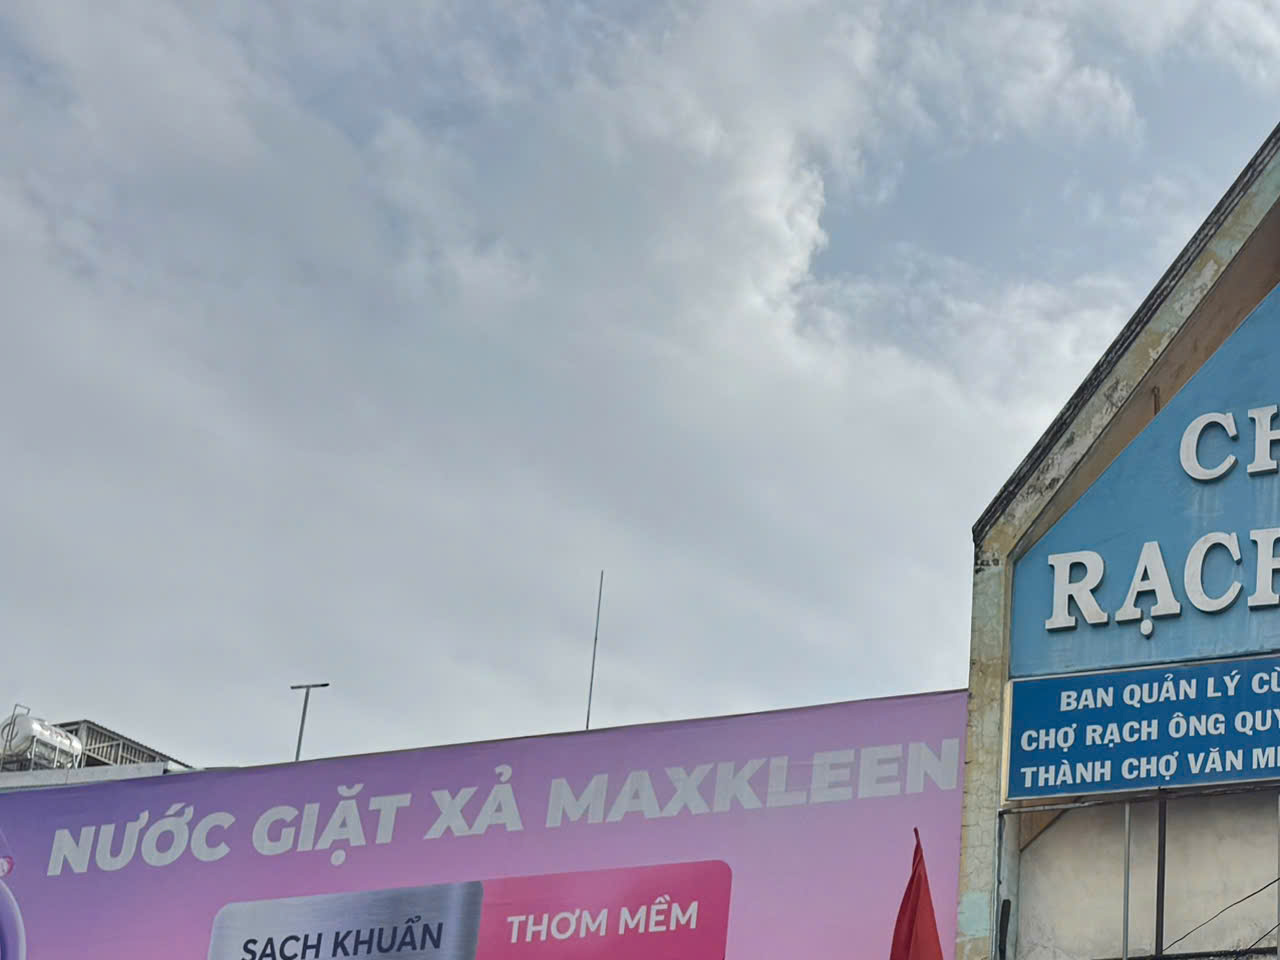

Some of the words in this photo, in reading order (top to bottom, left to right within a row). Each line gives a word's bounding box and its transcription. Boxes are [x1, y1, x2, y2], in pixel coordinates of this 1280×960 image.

[1060, 687, 1114, 712] BAN
[1123, 673, 1197, 708] QUẢN
[1207, 670, 1241, 698] LÝ
[1021, 723, 1077, 752] CHỢ
[1086, 719, 1158, 747] RẠCH
[1169, 712, 1226, 738] ÔNG
[1020, 760, 1111, 787] THÀNH
[1122, 752, 1178, 780] CHỢ
[1188, 747, 1243, 774] VĂN
[47, 802, 235, 876] NƯỚC
[252, 784, 411, 866] GIẶT
[424, 764, 524, 841] XẢ
[546, 738, 960, 828] MAXKLEEN
[332, 916, 443, 958] KHUẨN
[507, 908, 608, 943] THƠM
[619, 894, 698, 934] MỀM
